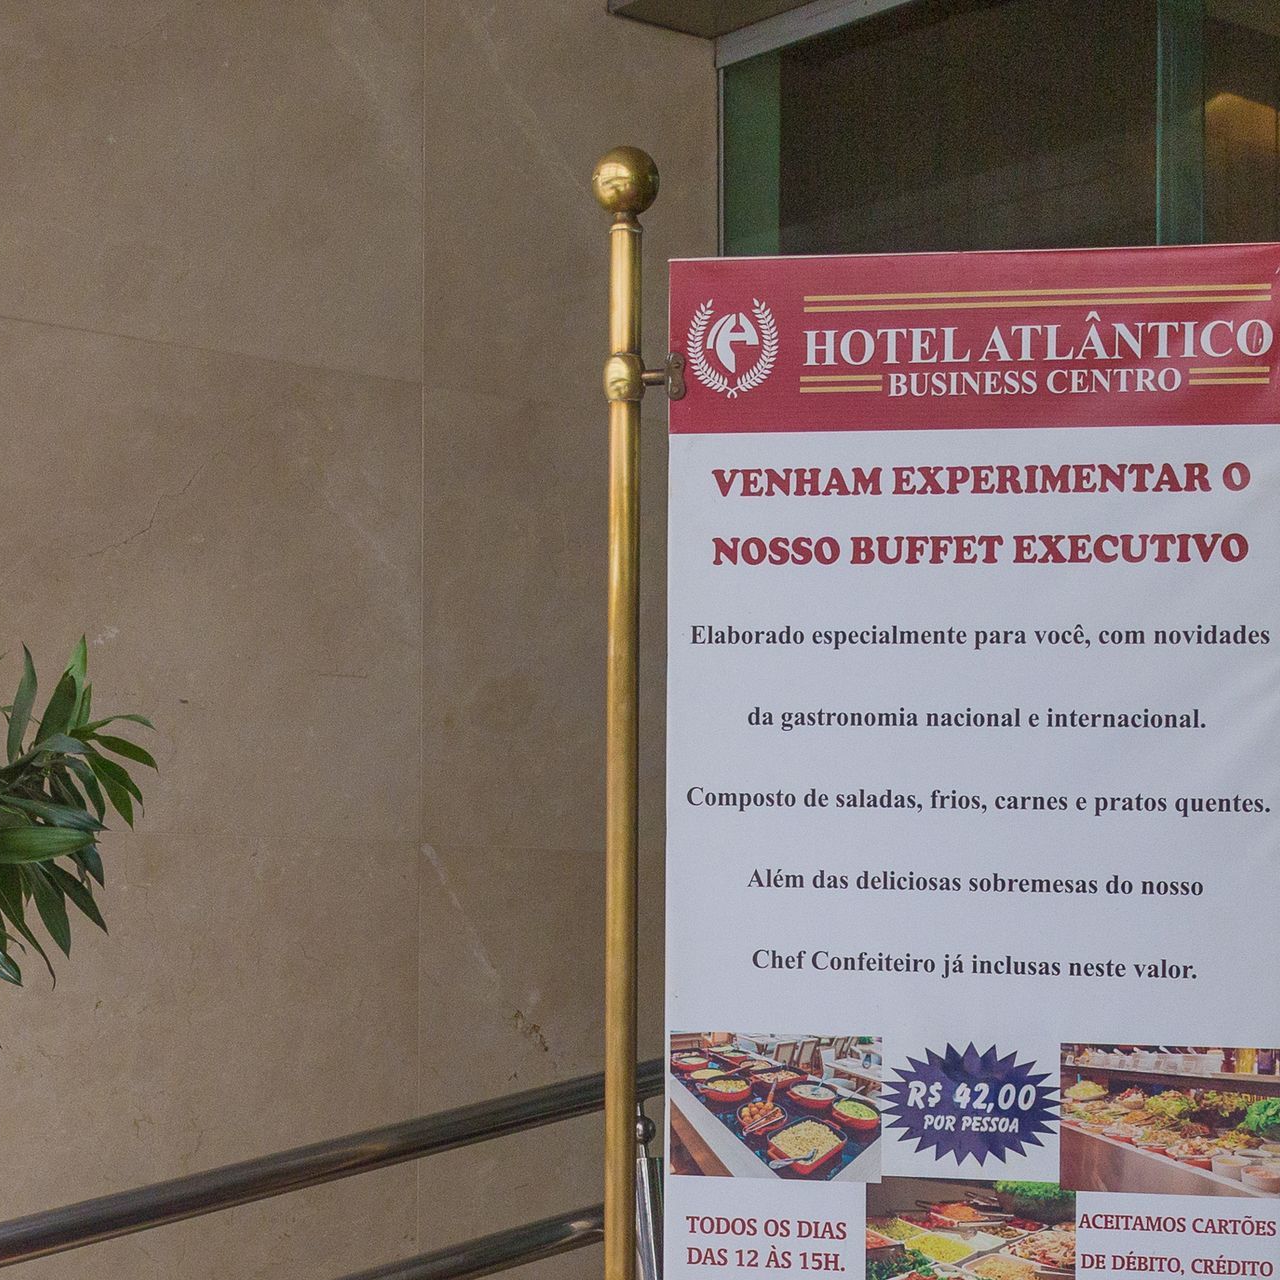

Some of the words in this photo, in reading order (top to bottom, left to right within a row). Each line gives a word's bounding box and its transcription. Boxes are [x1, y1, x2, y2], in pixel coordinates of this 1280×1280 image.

[805, 327, 970, 365] HOTEL
[979, 311, 1273, 361] ATLÂNTICO
[889, 370, 1037, 396] BUSINESS
[1047, 367, 1181, 393] CENTRO
[712, 467, 882, 497] VENHAM
[893, 463, 1211, 494] EXPERIMENTAR
[1223, 462, 1250, 491] O
[713, 537, 840, 565] NOSSO
[851, 535, 1003, 564] BUFFET
[1013, 533, 1248, 563] EXECUTIVO
[692, 626, 804, 644] Elaborado
[812, 625, 967, 650] especialmente
[975, 631, 1026, 650] para
[1035, 624, 1090, 647] você,
[1099, 631, 1144, 644] com
[1155, 625, 1270, 644] novidades
[748, 707, 773, 725] da
[781, 707, 918, 731] gastronomia
[927, 708, 1020, 727] nacional
[1028, 714, 1039, 727] e
[1048, 708, 1205, 728] internacional.
[687, 787, 796, 812] Composto
[804, 789, 828, 807] de
[836, 789, 922, 811] saladas,
[931, 790, 987, 812] frios,
[995, 796, 1067, 810] carnes
[1076, 797, 1086, 810] e
[1095, 794, 1167, 816] pratos
[1175, 795, 1270, 817] quentes.
[748, 869, 804, 888] Além
[812, 870, 848, 889] das
[856, 871, 961, 891] deliciosas
[969, 873, 1098, 893] sobremesas
[1106, 875, 1133, 894] do
[1142, 881, 1203, 895] nosso
[752, 950, 806, 969] Chef
[812, 951, 935, 972] Confeiteiro
[942, 954, 963, 978] já
[973, 955, 1060, 975] inclusas
[1070, 961, 1126, 977] neste
[1134, 959, 1196, 979] valor.
[907, 1081, 942, 1109] R$
[953, 1083, 1035, 1113] 42,00
[924, 1115, 956, 1131] POR
[961, 1116, 1018, 1132] PESSOA
[686, 1216, 757, 1236] TODOS
[764, 1219, 790, 1237] OS
[797, 1221, 846, 1240] DIAS
[1079, 1214, 1186, 1232] ACEITAMOS
[1192, 1216, 1276, 1236] CARTÕES
[687, 1247, 728, 1266] DAS
[736, 1250, 758, 1267] 12
[765, 1245, 792, 1269] ÀS
[800, 1252, 845, 1271] 15H.
[1081, 1254, 1106, 1269] DE
[1112, 1251, 1184, 1275] DÉBITO,
[1191, 1255, 1273, 1277] CRÉDITO
